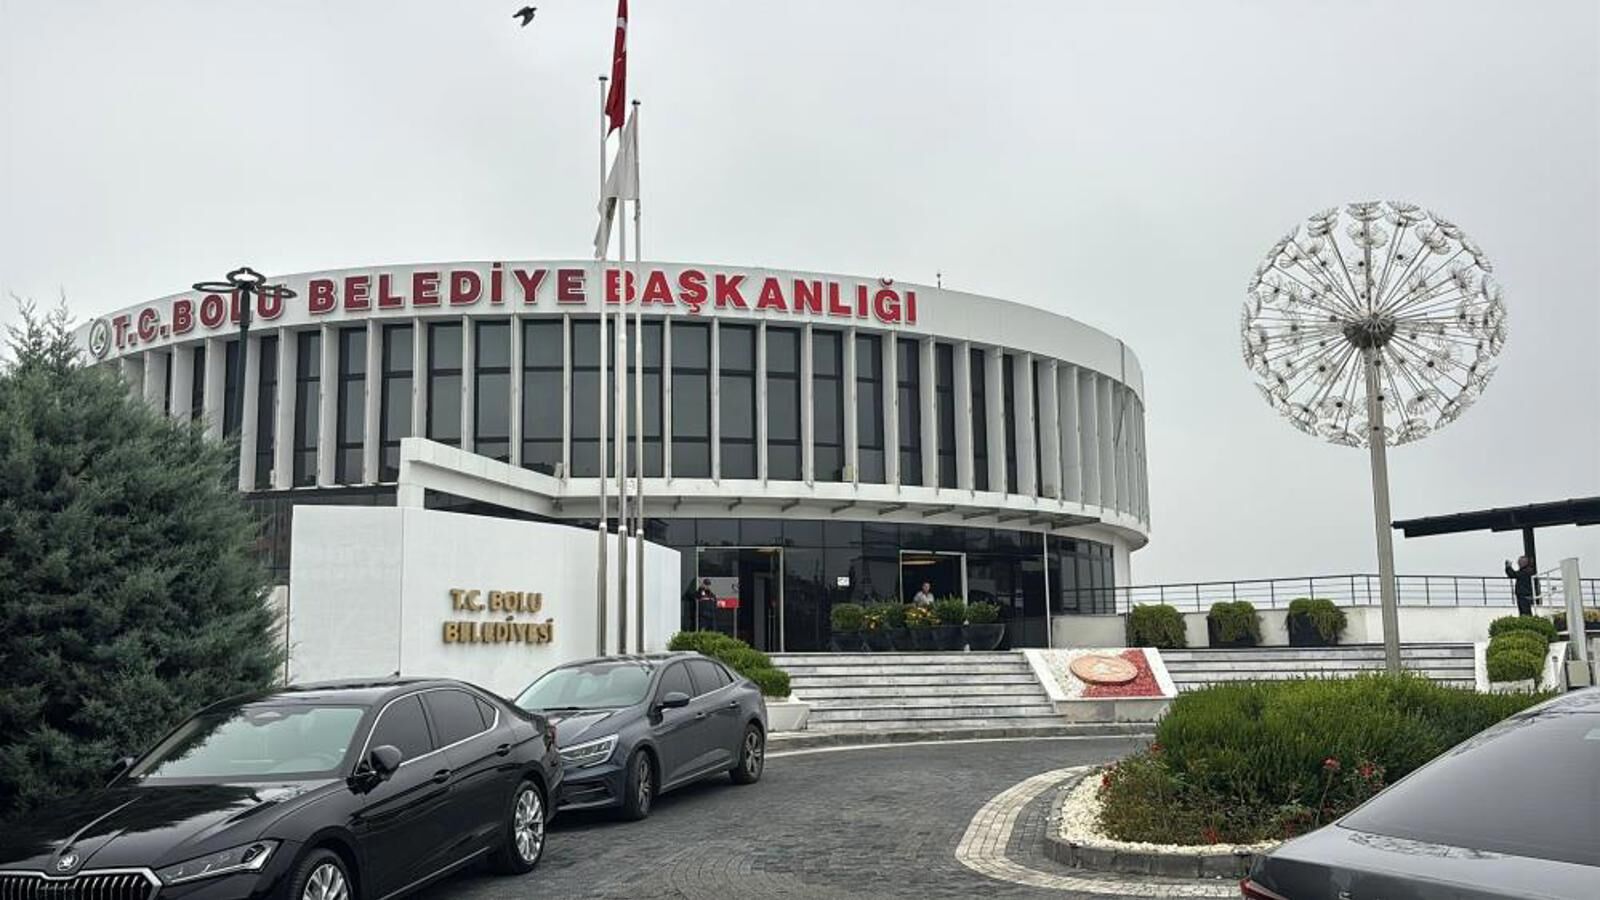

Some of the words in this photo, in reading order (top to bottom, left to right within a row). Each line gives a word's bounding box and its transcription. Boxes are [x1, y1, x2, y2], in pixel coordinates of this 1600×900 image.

[308, 262, 587, 314] BELEDİYE
[604, 268, 917, 324] BAŞKANLIĞI
[488, 590, 542, 613] BOLU
